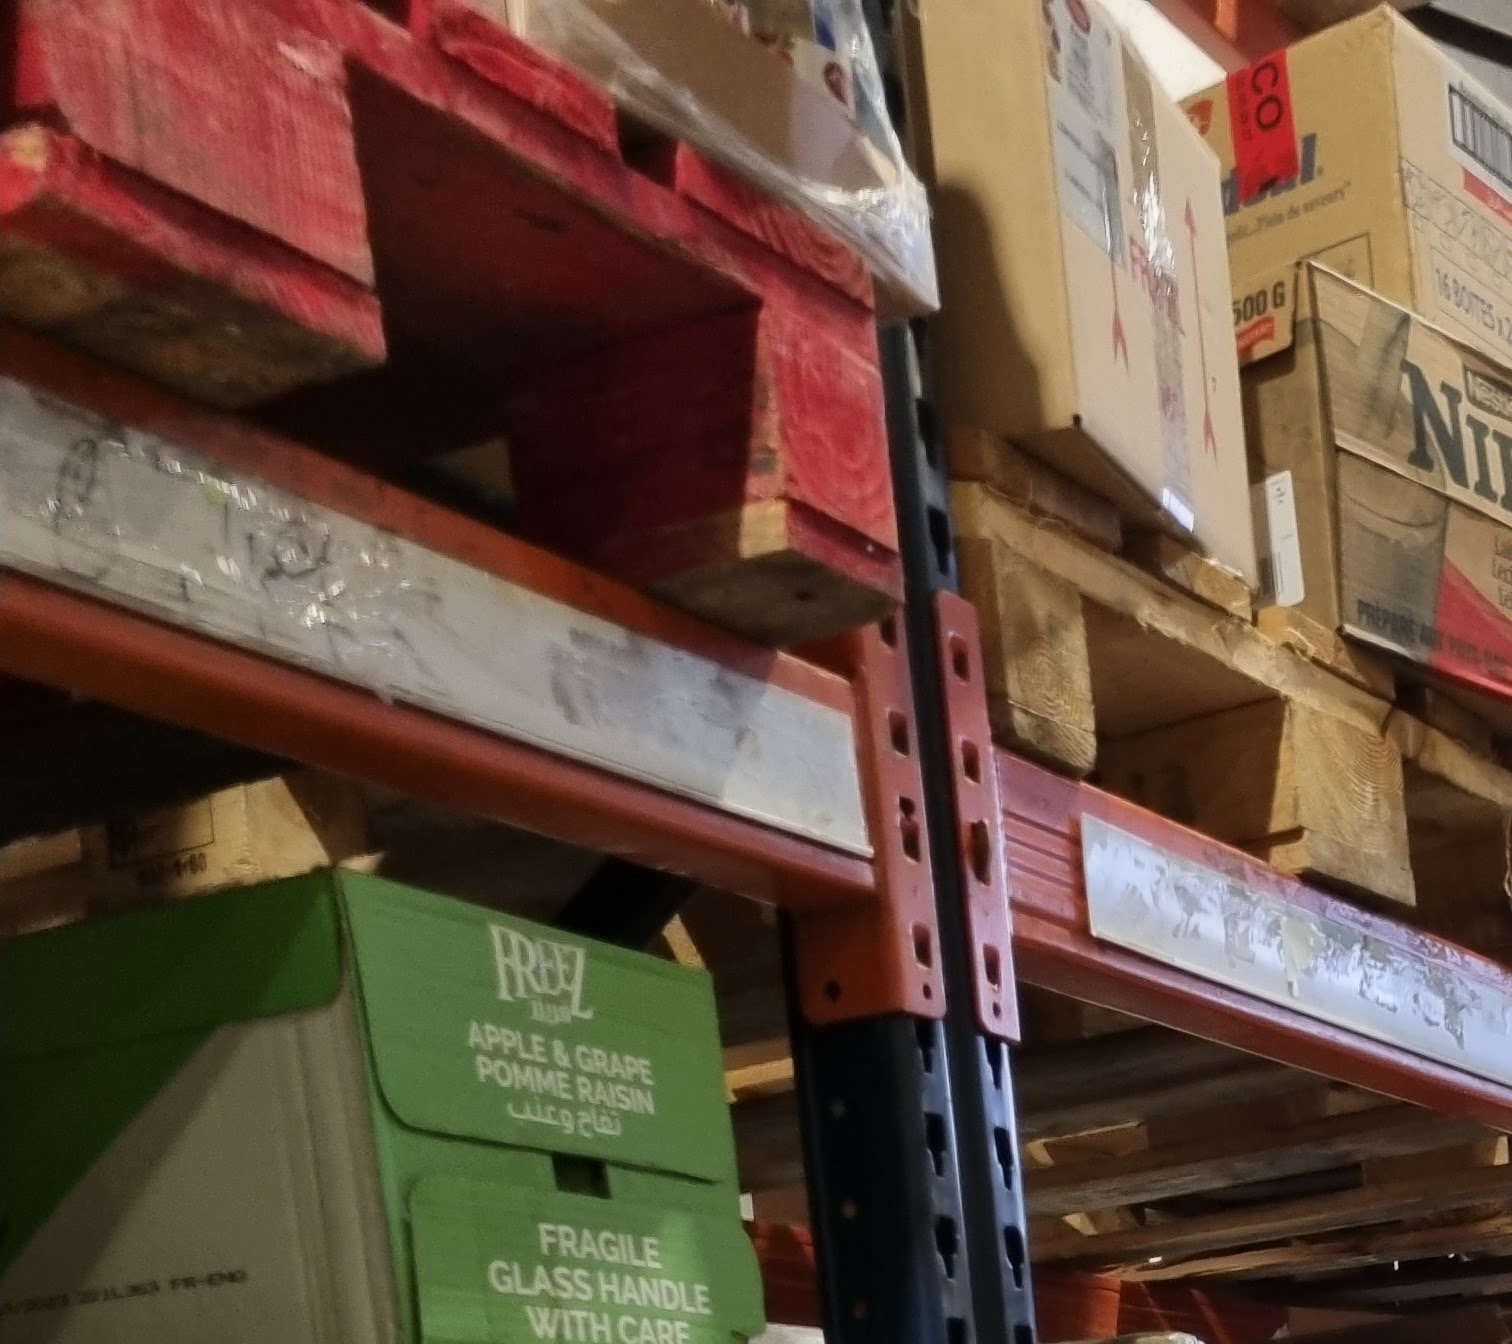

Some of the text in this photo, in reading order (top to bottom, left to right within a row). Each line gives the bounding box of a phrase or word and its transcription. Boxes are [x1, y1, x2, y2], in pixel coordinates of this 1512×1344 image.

[468, 1020, 655, 1086] APPLE & GRAPE
[475, 1054, 655, 1116] POMME RAISIN
[537, 1222, 664, 1269] FRAGILE
[487, 1259, 713, 1316] GLASS HANDLE
[524, 1304, 613, 1344] WITH
